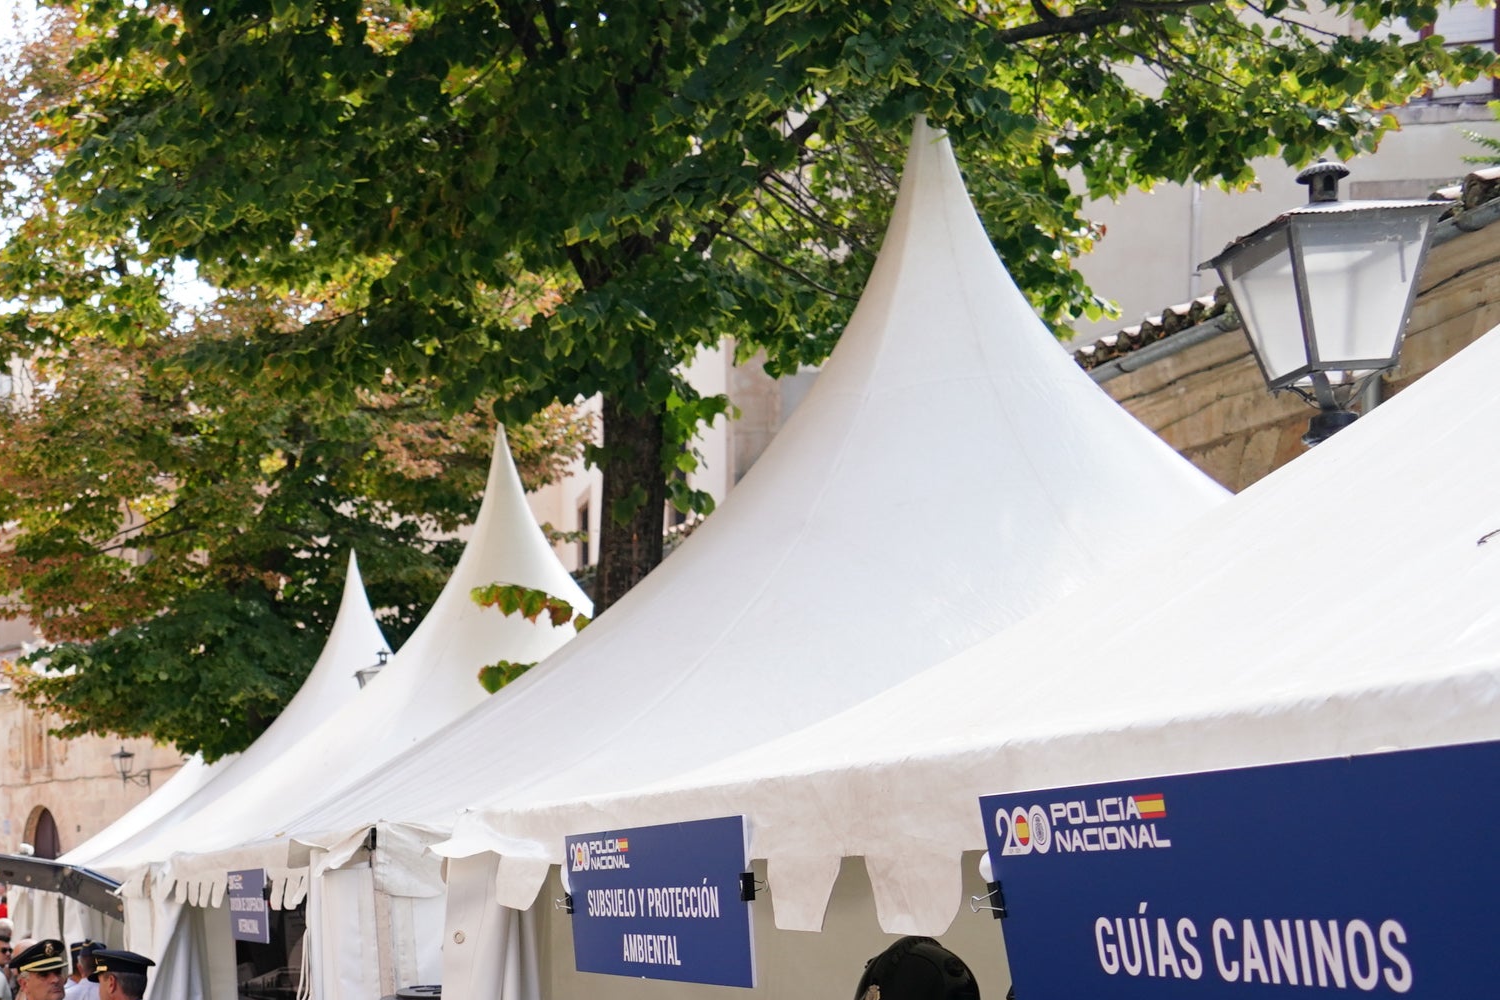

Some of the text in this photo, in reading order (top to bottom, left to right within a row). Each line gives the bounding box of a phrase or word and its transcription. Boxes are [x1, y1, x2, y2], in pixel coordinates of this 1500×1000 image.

[1054, 823, 1171, 853] NACIONAL
[591, 855, 630, 870] NACIONAL
[587, 878, 720, 918] SUBSUELO Y PROTECCIÓN
[623, 934, 681, 965] AMBIENTAL
[1095, 902, 1413, 993] GUÍAS CANINOS
